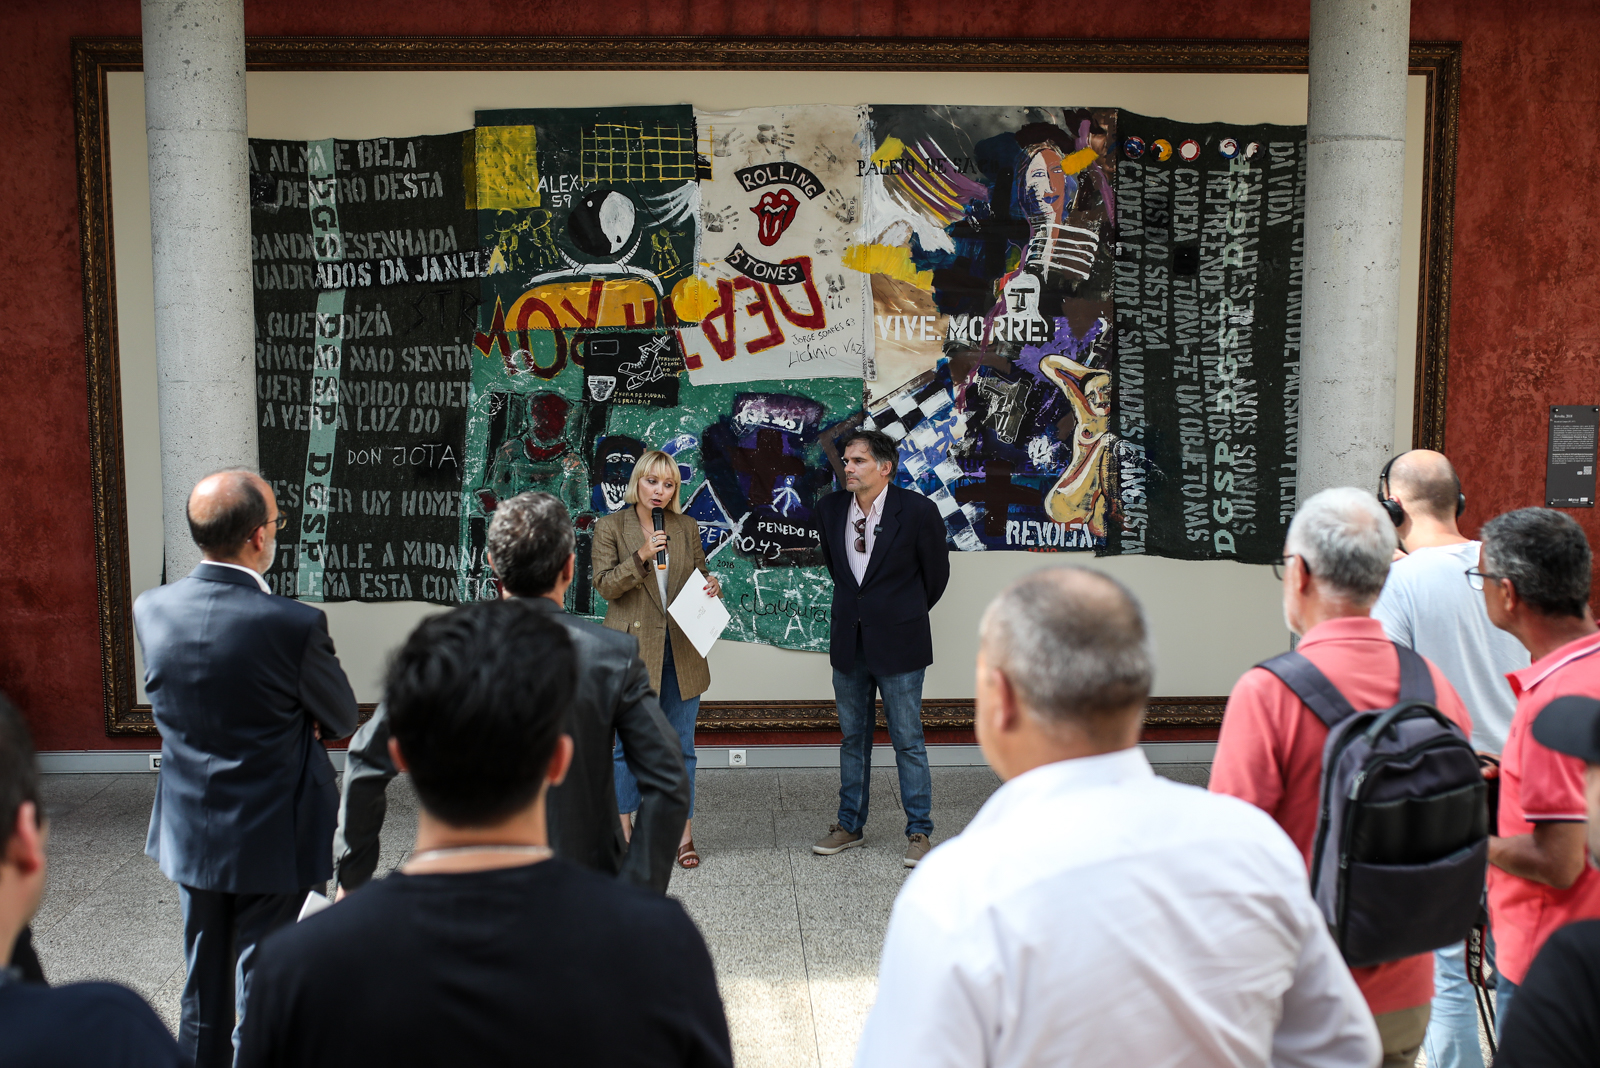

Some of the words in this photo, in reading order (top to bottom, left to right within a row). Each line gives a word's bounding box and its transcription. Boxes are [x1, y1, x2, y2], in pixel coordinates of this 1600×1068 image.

[270, 144, 327, 173] ALMA
[335, 142, 351, 171] E
[358, 138, 417, 170] BELA
[926, 157, 948, 175] DE
[1269, 141, 1296, 170] DA
[374, 171, 443, 203] DESTA
[742, 165, 818, 197] ROLLING
[1116, 160, 1145, 238] CADEIA
[1173, 167, 1200, 242] CADEIA
[1266, 173, 1294, 226] VIDA
[325, 225, 458, 261] DESENHADA
[1115, 241, 1142, 260] E
[1143, 226, 1170, 260] DO
[380, 258, 409, 287] DA
[730, 248, 798, 281] STONES
[1114, 260, 1141, 306] DOR
[1116, 308, 1142, 326] E
[1141, 264, 1171, 350] SISTEMA
[791, 332, 816, 346] JORGE
[876, 315, 942, 341] VIVE.
[415, 381, 468, 408] QUE
[1117, 327, 1146, 440] SAUDADES
[262, 401, 276, 428] A
[336, 404, 349, 431] A
[357, 406, 400, 433] LUZ
[409, 406, 441, 434] DO
[347, 447, 382, 467] DON
[392, 443, 459, 469] JOTA
[1178, 417, 1209, 499] OBJETO
[301, 452, 331, 562] DGSP
[362, 490, 391, 516] UM
[401, 489, 461, 517] HOME
[1212, 441, 1238, 554] DGSP
[757, 521, 805, 537] PENEDO
[382, 541, 396, 567] A
[360, 572, 413, 599] ESTA
